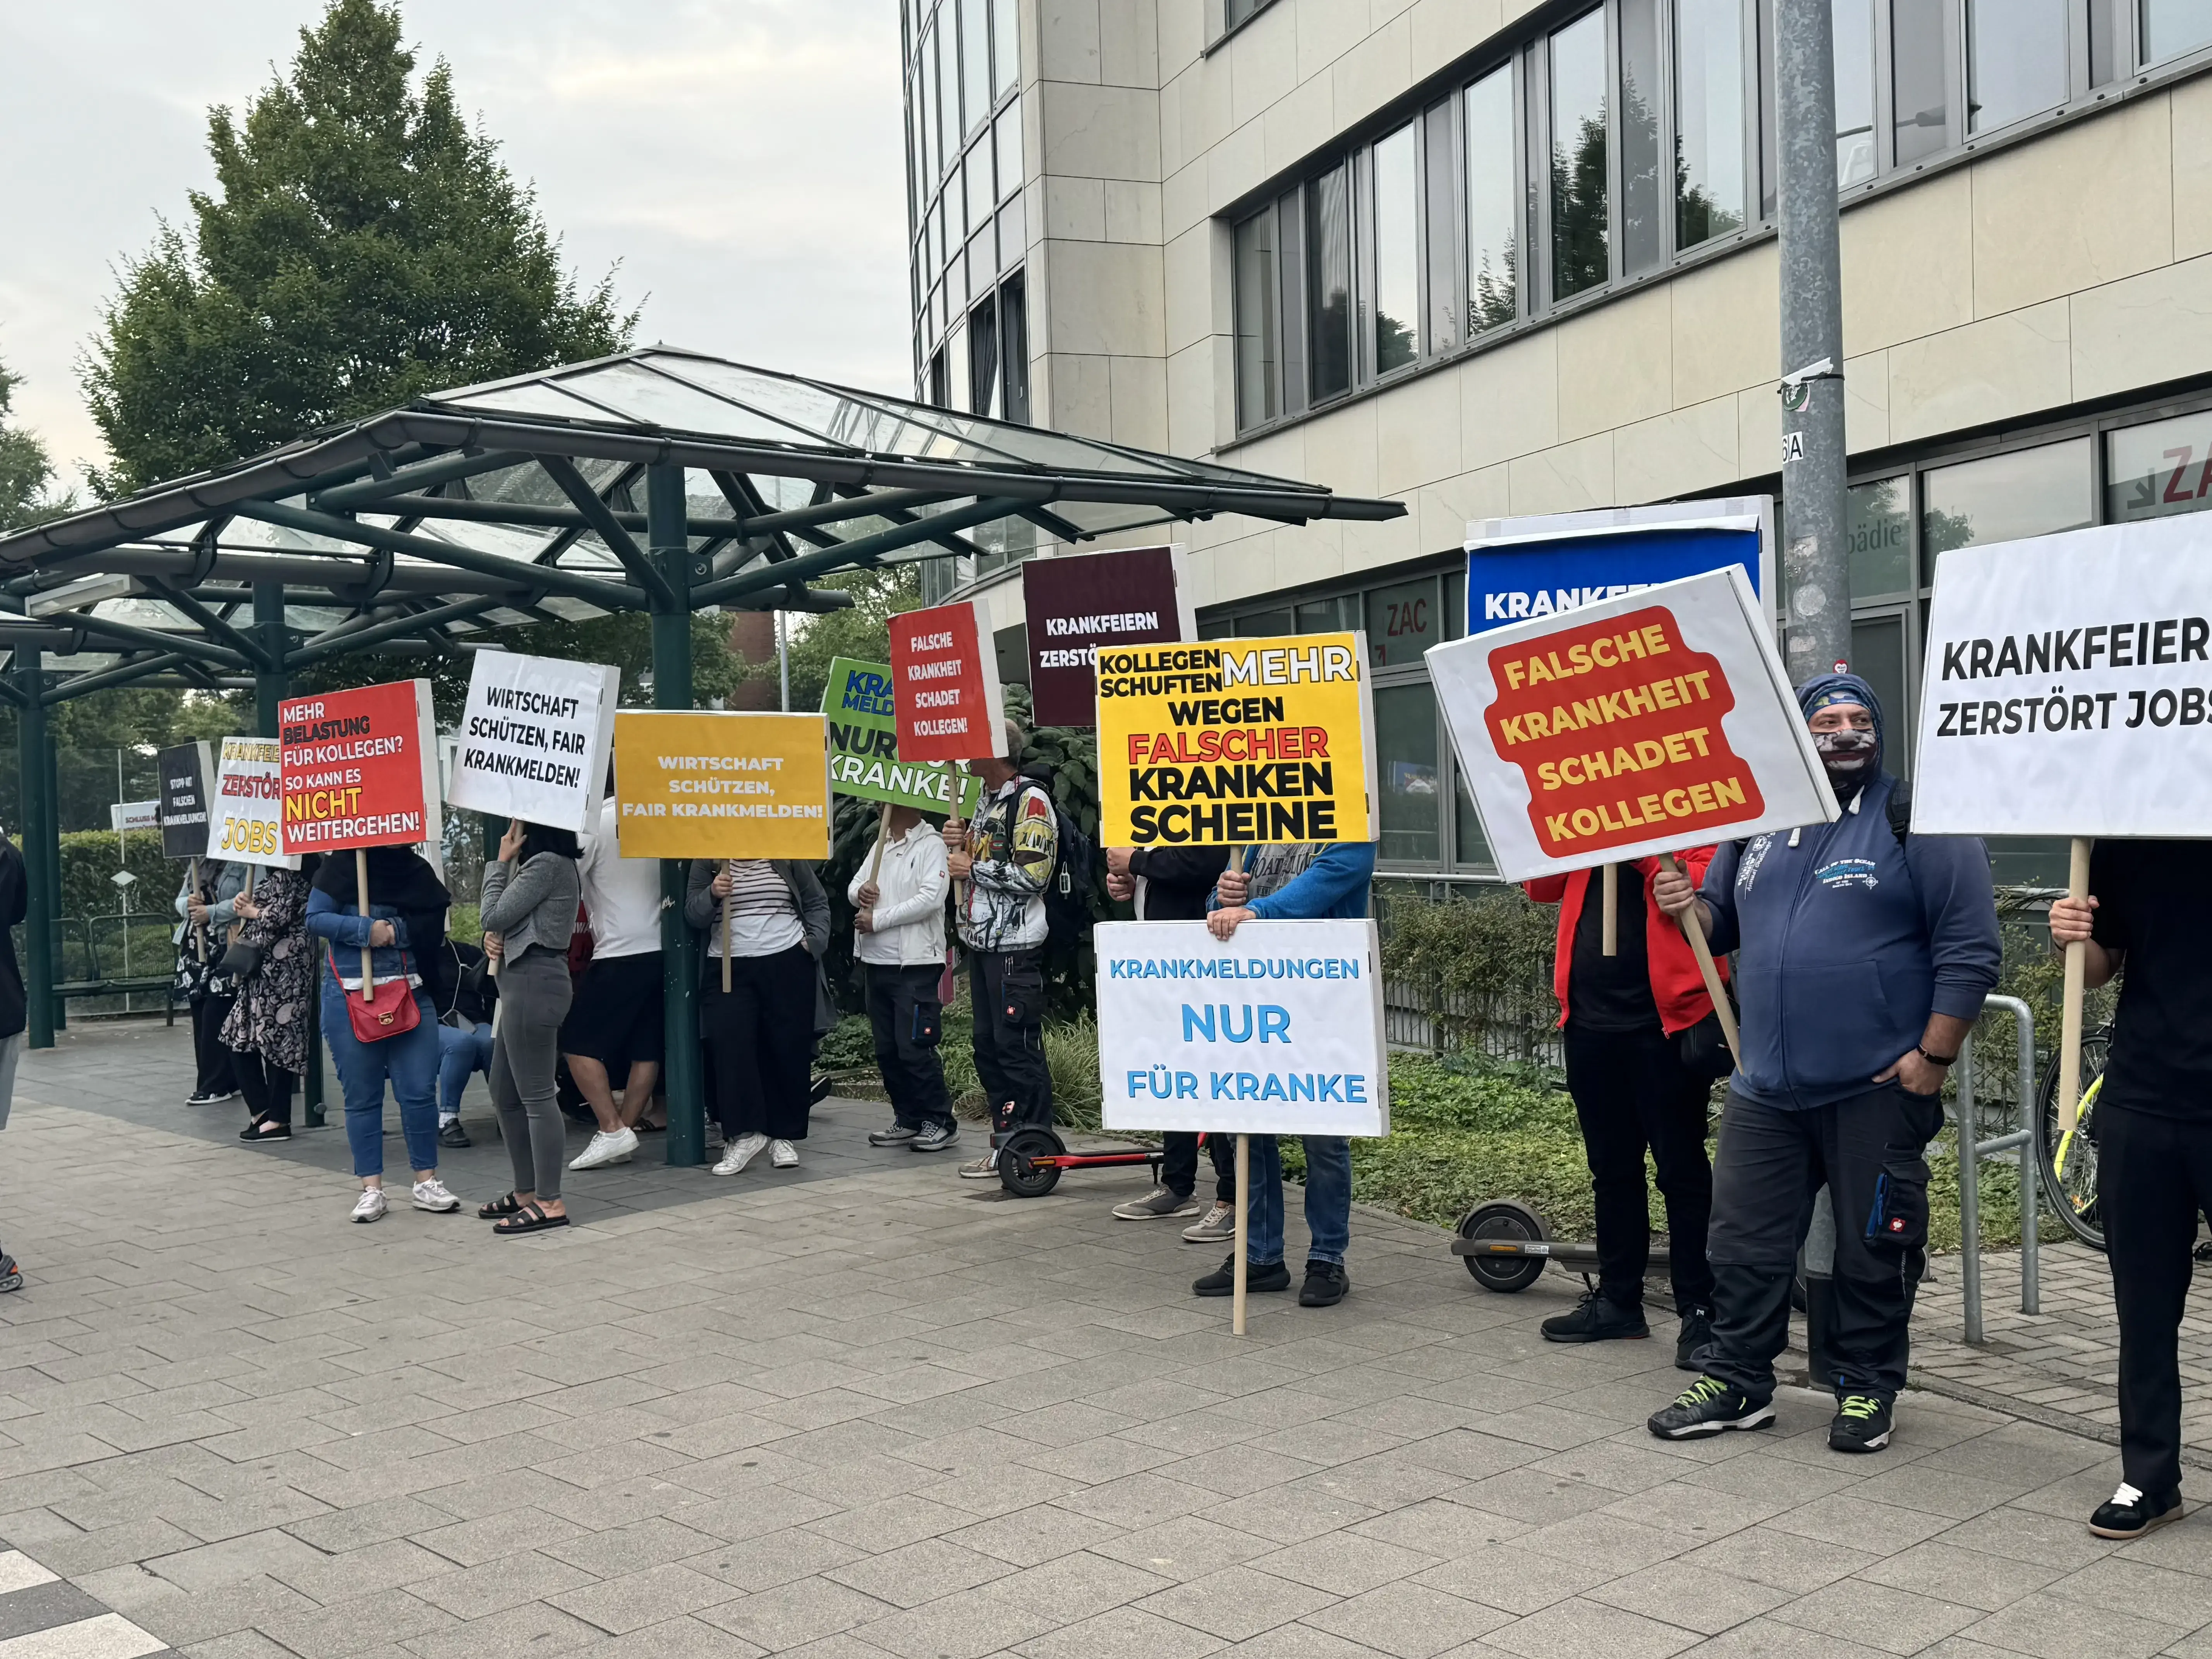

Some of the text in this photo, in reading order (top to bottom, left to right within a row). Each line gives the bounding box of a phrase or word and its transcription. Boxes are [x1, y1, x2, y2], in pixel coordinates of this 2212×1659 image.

[1046, 611, 1158, 635] KRANKFEIERN
[1387, 598, 1427, 637] ZAC
[911, 631, 953, 652] FALSCHE
[1503, 624, 1671, 690] FALSCHE
[1942, 617, 2210, 680] KRANKFEIER
[908, 659, 962, 681] KRANKHEIT
[1100, 649, 1221, 675] KOLLEGEN
[1222, 645, 1355, 688] MEHR
[915, 689, 960, 708] SCHADET
[1101, 673, 1223, 697] SCHUFTEN
[283, 702, 325, 724] MEHR
[487, 686, 579, 719] WIRTSCHAFT
[1168, 697, 1284, 726] WEGEN
[1499, 670, 1711, 745] KRANKHEIT
[1937, 685, 2212, 737] ZERSTÖRT JOB
[283, 716, 370, 745] BELASTUNG
[469, 716, 586, 755] SCHÜTZEN, FAIR
[830, 721, 897, 761] NUR
[914, 718, 967, 736] KOLLEGEN!
[284, 735, 403, 768] FÜR KOLLEGEN?
[1128, 726, 1331, 764] FALSCHER
[1537, 727, 1710, 790] SCHADET
[285, 768, 362, 791] SO KANN ES
[464, 748, 580, 788] KRANKMELDEN!
[658, 756, 784, 771] WIRTSCHAFT
[669, 777, 775, 796] SCHÜTZEN,
[1129, 761, 1333, 801] KRANKEN
[286, 786, 362, 822] NICHT
[623, 803, 823, 818] FAIR KRANKMELDEN!
[1545, 776, 1747, 842] KOLLEGEN
[221, 817, 278, 855] JOBS
[287, 811, 420, 843] WEITERGEHEN!
[1130, 800, 1338, 843] SCHEINE
[1110, 958, 1359, 979] KRANKMELDUNGEN
[1181, 1003, 1292, 1043] NUR
[1127, 1064, 1367, 1103] FÜR KRANKE
